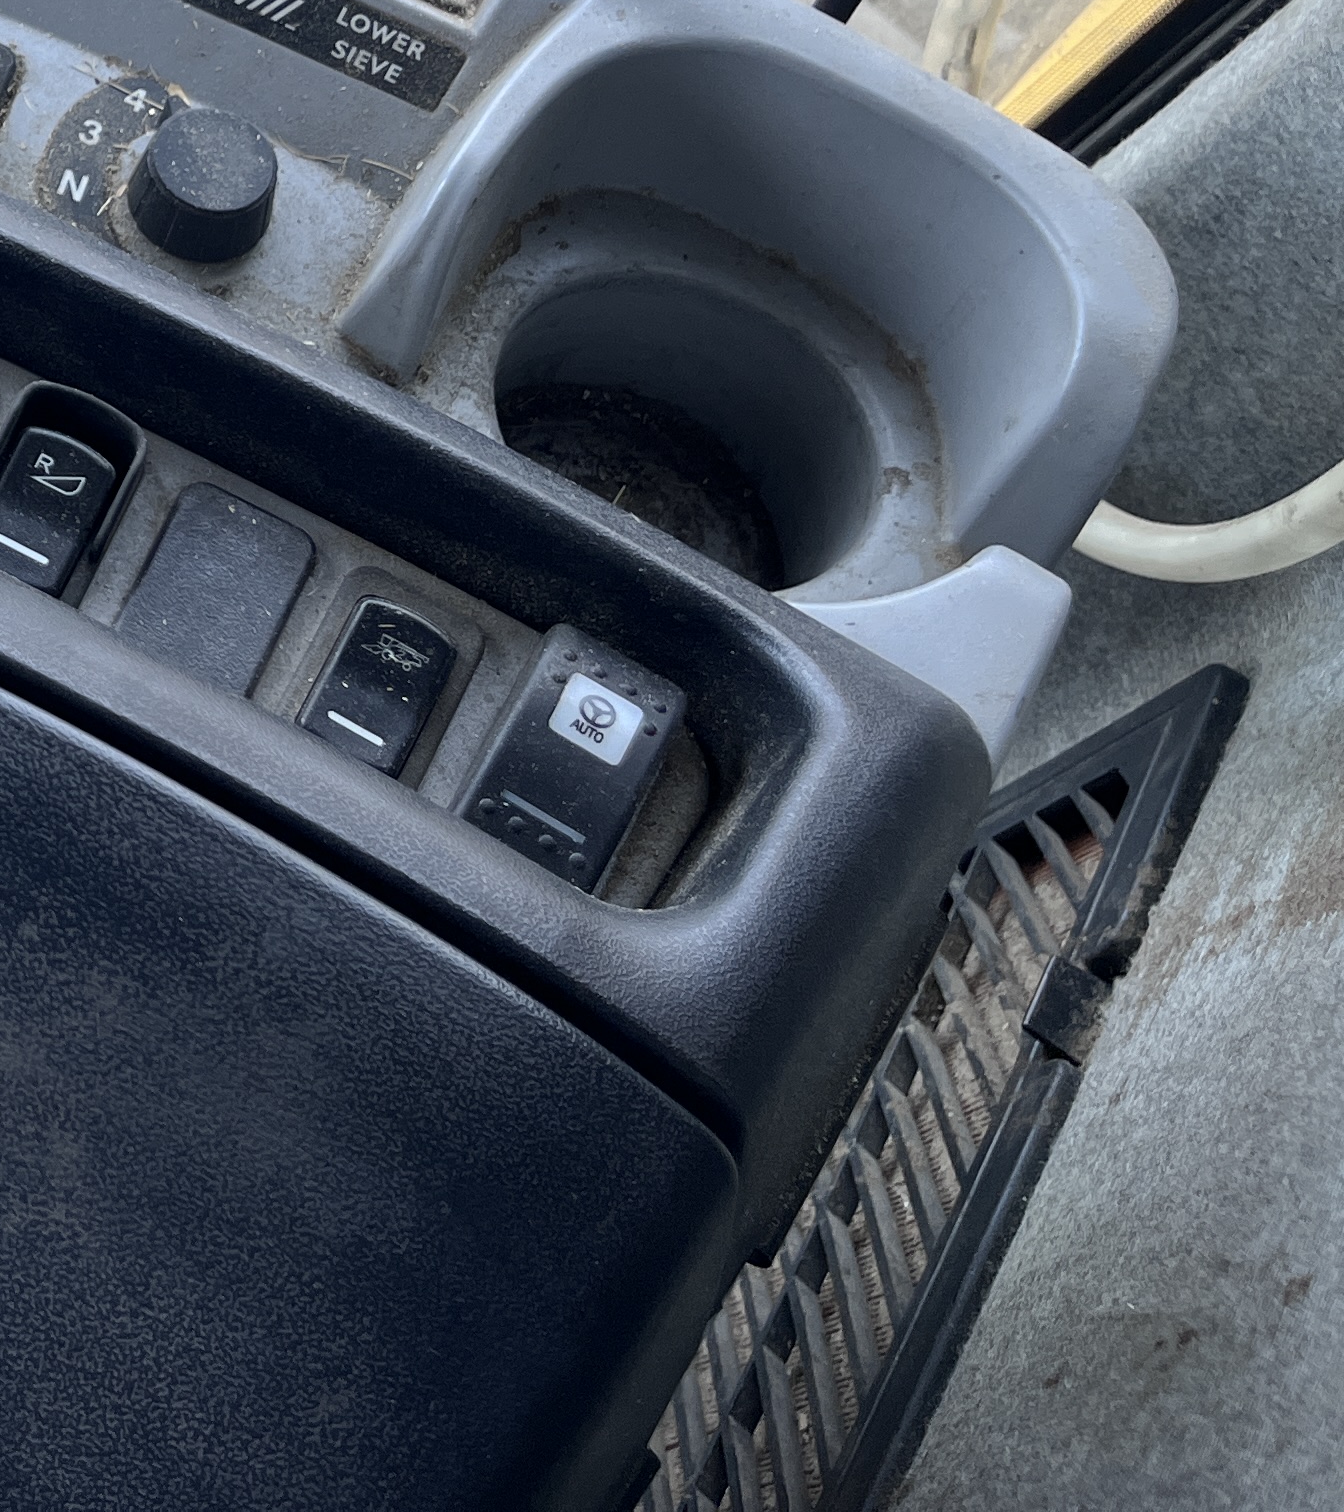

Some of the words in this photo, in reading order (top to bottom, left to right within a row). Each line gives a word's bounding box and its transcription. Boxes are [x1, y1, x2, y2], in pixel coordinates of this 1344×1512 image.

[335, 6, 427, 62] LOWER
[330, 38, 404, 85] SIEVE
[123, 87, 147, 113] 4
[78, 119, 103, 147] 3
[56, 169, 90, 203] N
[33, 452, 54, 475] R
[569, 718, 604, 744] AUTO
